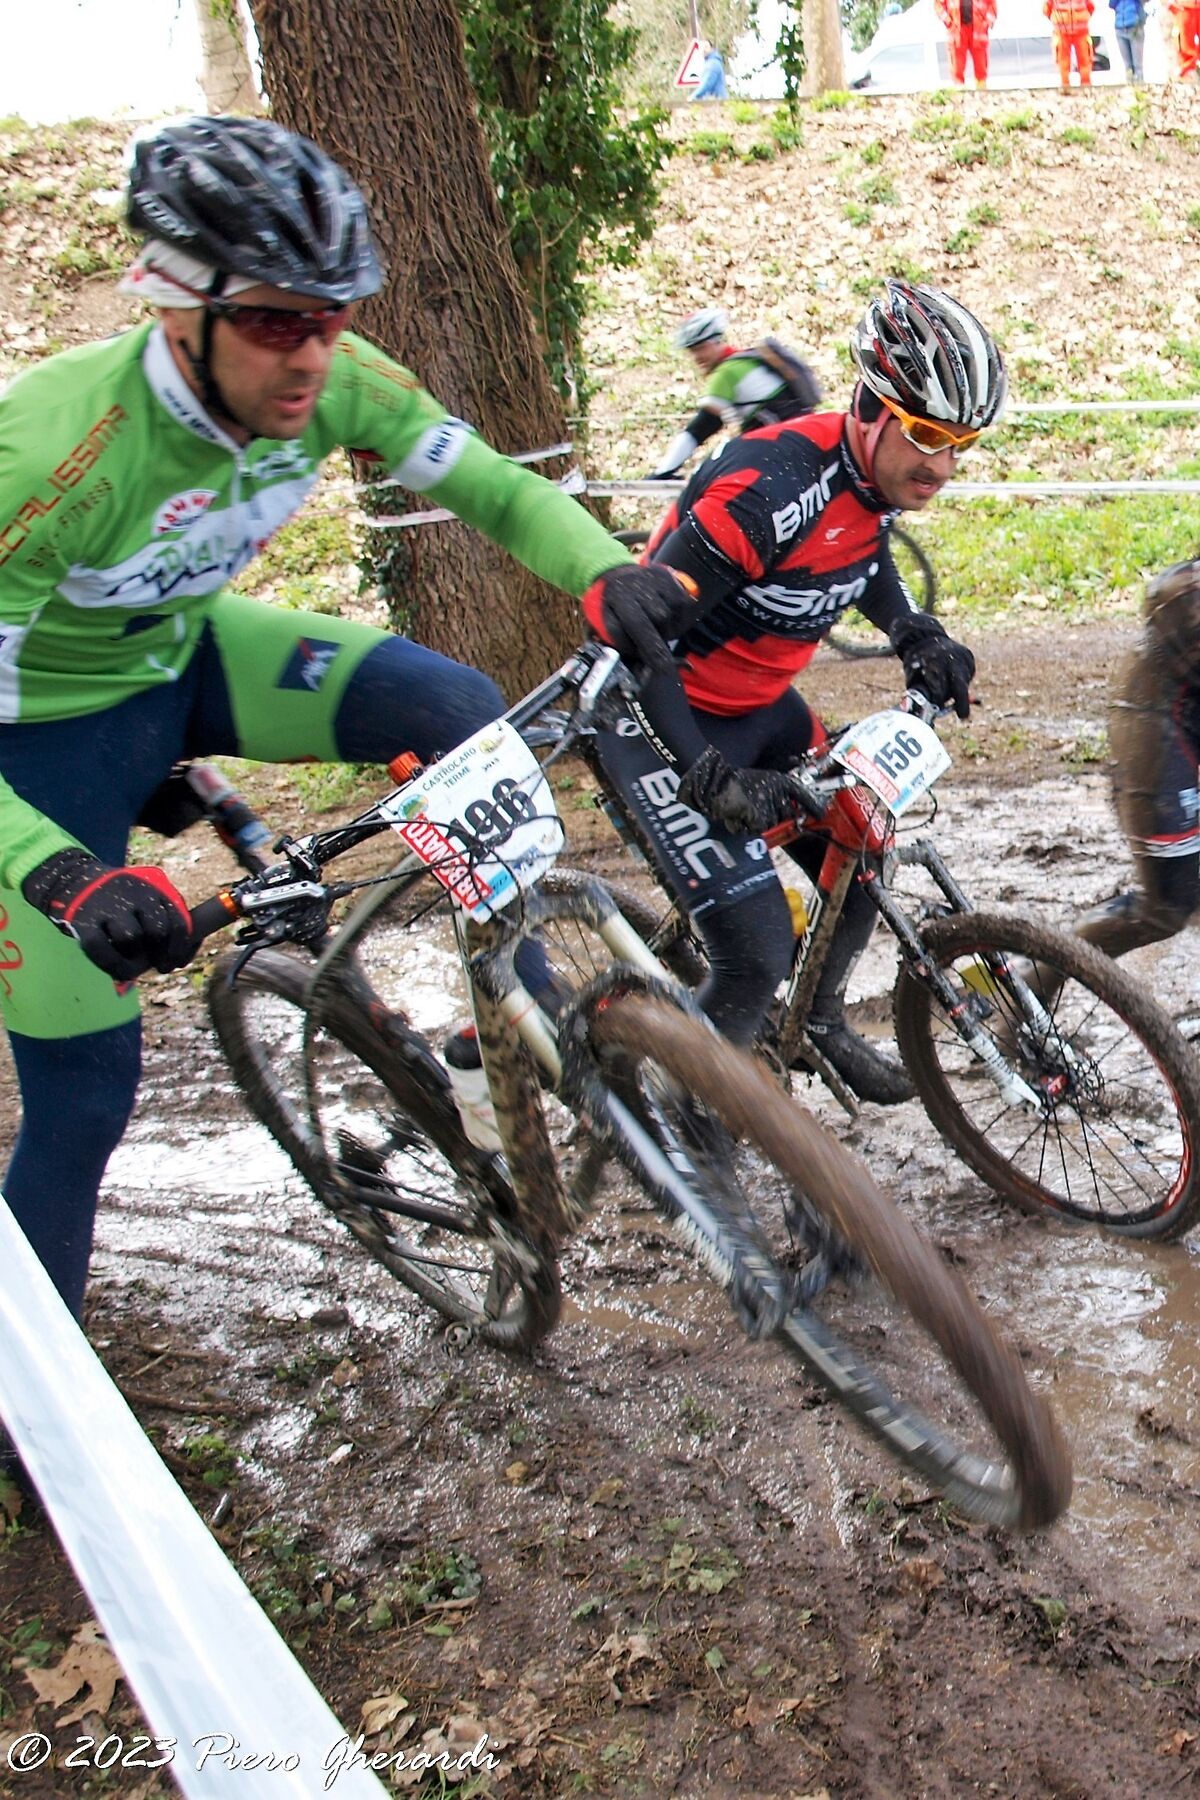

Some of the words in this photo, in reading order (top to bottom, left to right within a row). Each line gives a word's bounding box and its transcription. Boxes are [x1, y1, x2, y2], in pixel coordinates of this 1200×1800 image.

[422, 747, 477, 792] CASTROCARO
[443, 765, 471, 790] TERME
[873, 730, 922, 779] 156
[446, 778, 538, 864] 196
[630, 782, 689, 875] SWITZERLAND
[639, 767, 737, 880] BMC
